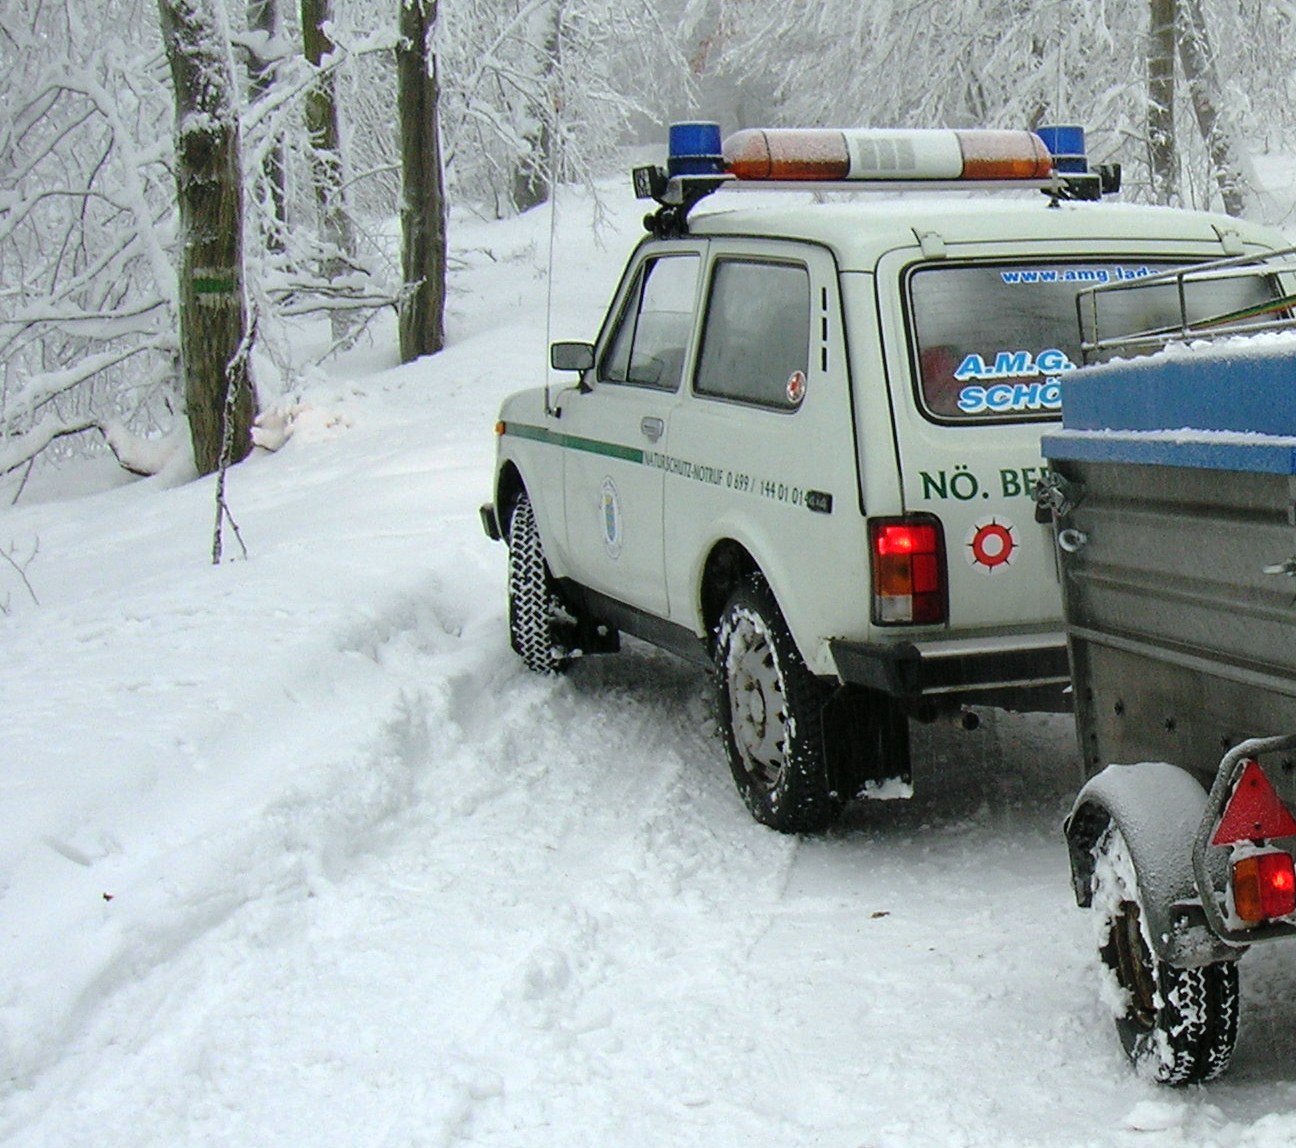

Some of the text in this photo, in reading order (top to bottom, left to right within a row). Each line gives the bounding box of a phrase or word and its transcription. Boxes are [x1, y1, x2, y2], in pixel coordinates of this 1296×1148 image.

[955, 351, 1073, 381] A.M.G.
[734, 473, 750, 492] 699
[760, 480, 777, 500] 144
[778, 483, 789, 503] 01
[919, 464, 1049, 501] NÖ. BE
